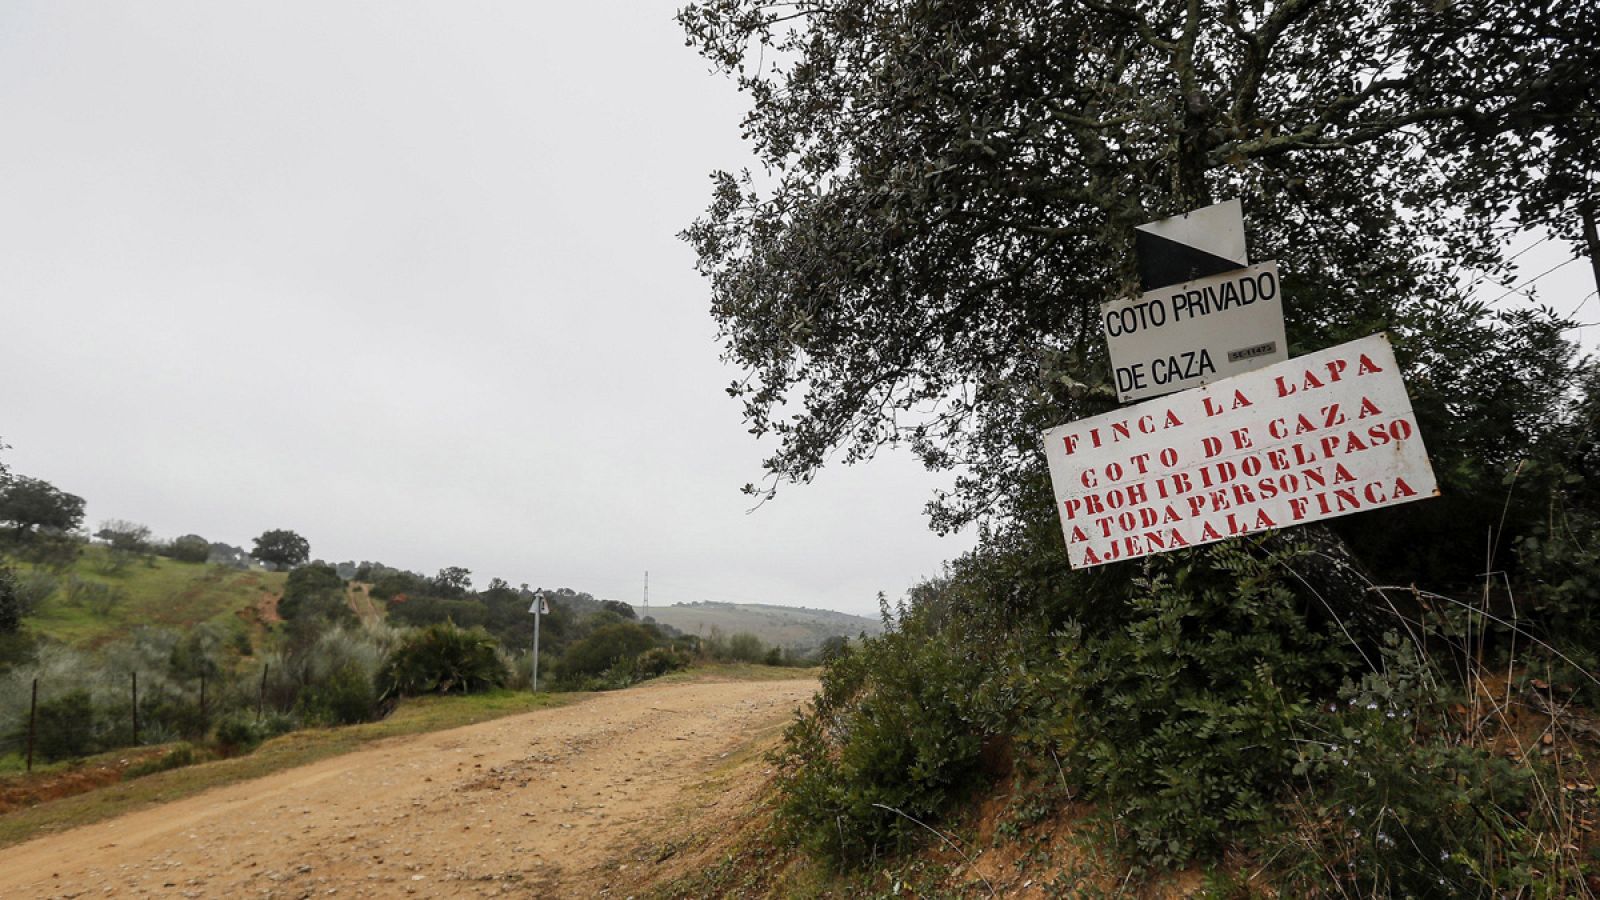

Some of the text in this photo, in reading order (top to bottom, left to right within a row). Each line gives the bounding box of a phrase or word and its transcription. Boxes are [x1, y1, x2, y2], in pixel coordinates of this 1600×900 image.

[1107, 271, 1276, 338] COTO PRIVADO
[1063, 353, 1383, 455] FINCA LA LAPA
[1115, 349, 1217, 393] DE CAZA
[1081, 396, 1383, 489] COTO DE CAZA
[1070, 524, 1089, 545] A
[1083, 527, 1189, 566] AJENA
[1288, 477, 1418, 521] FINCA
